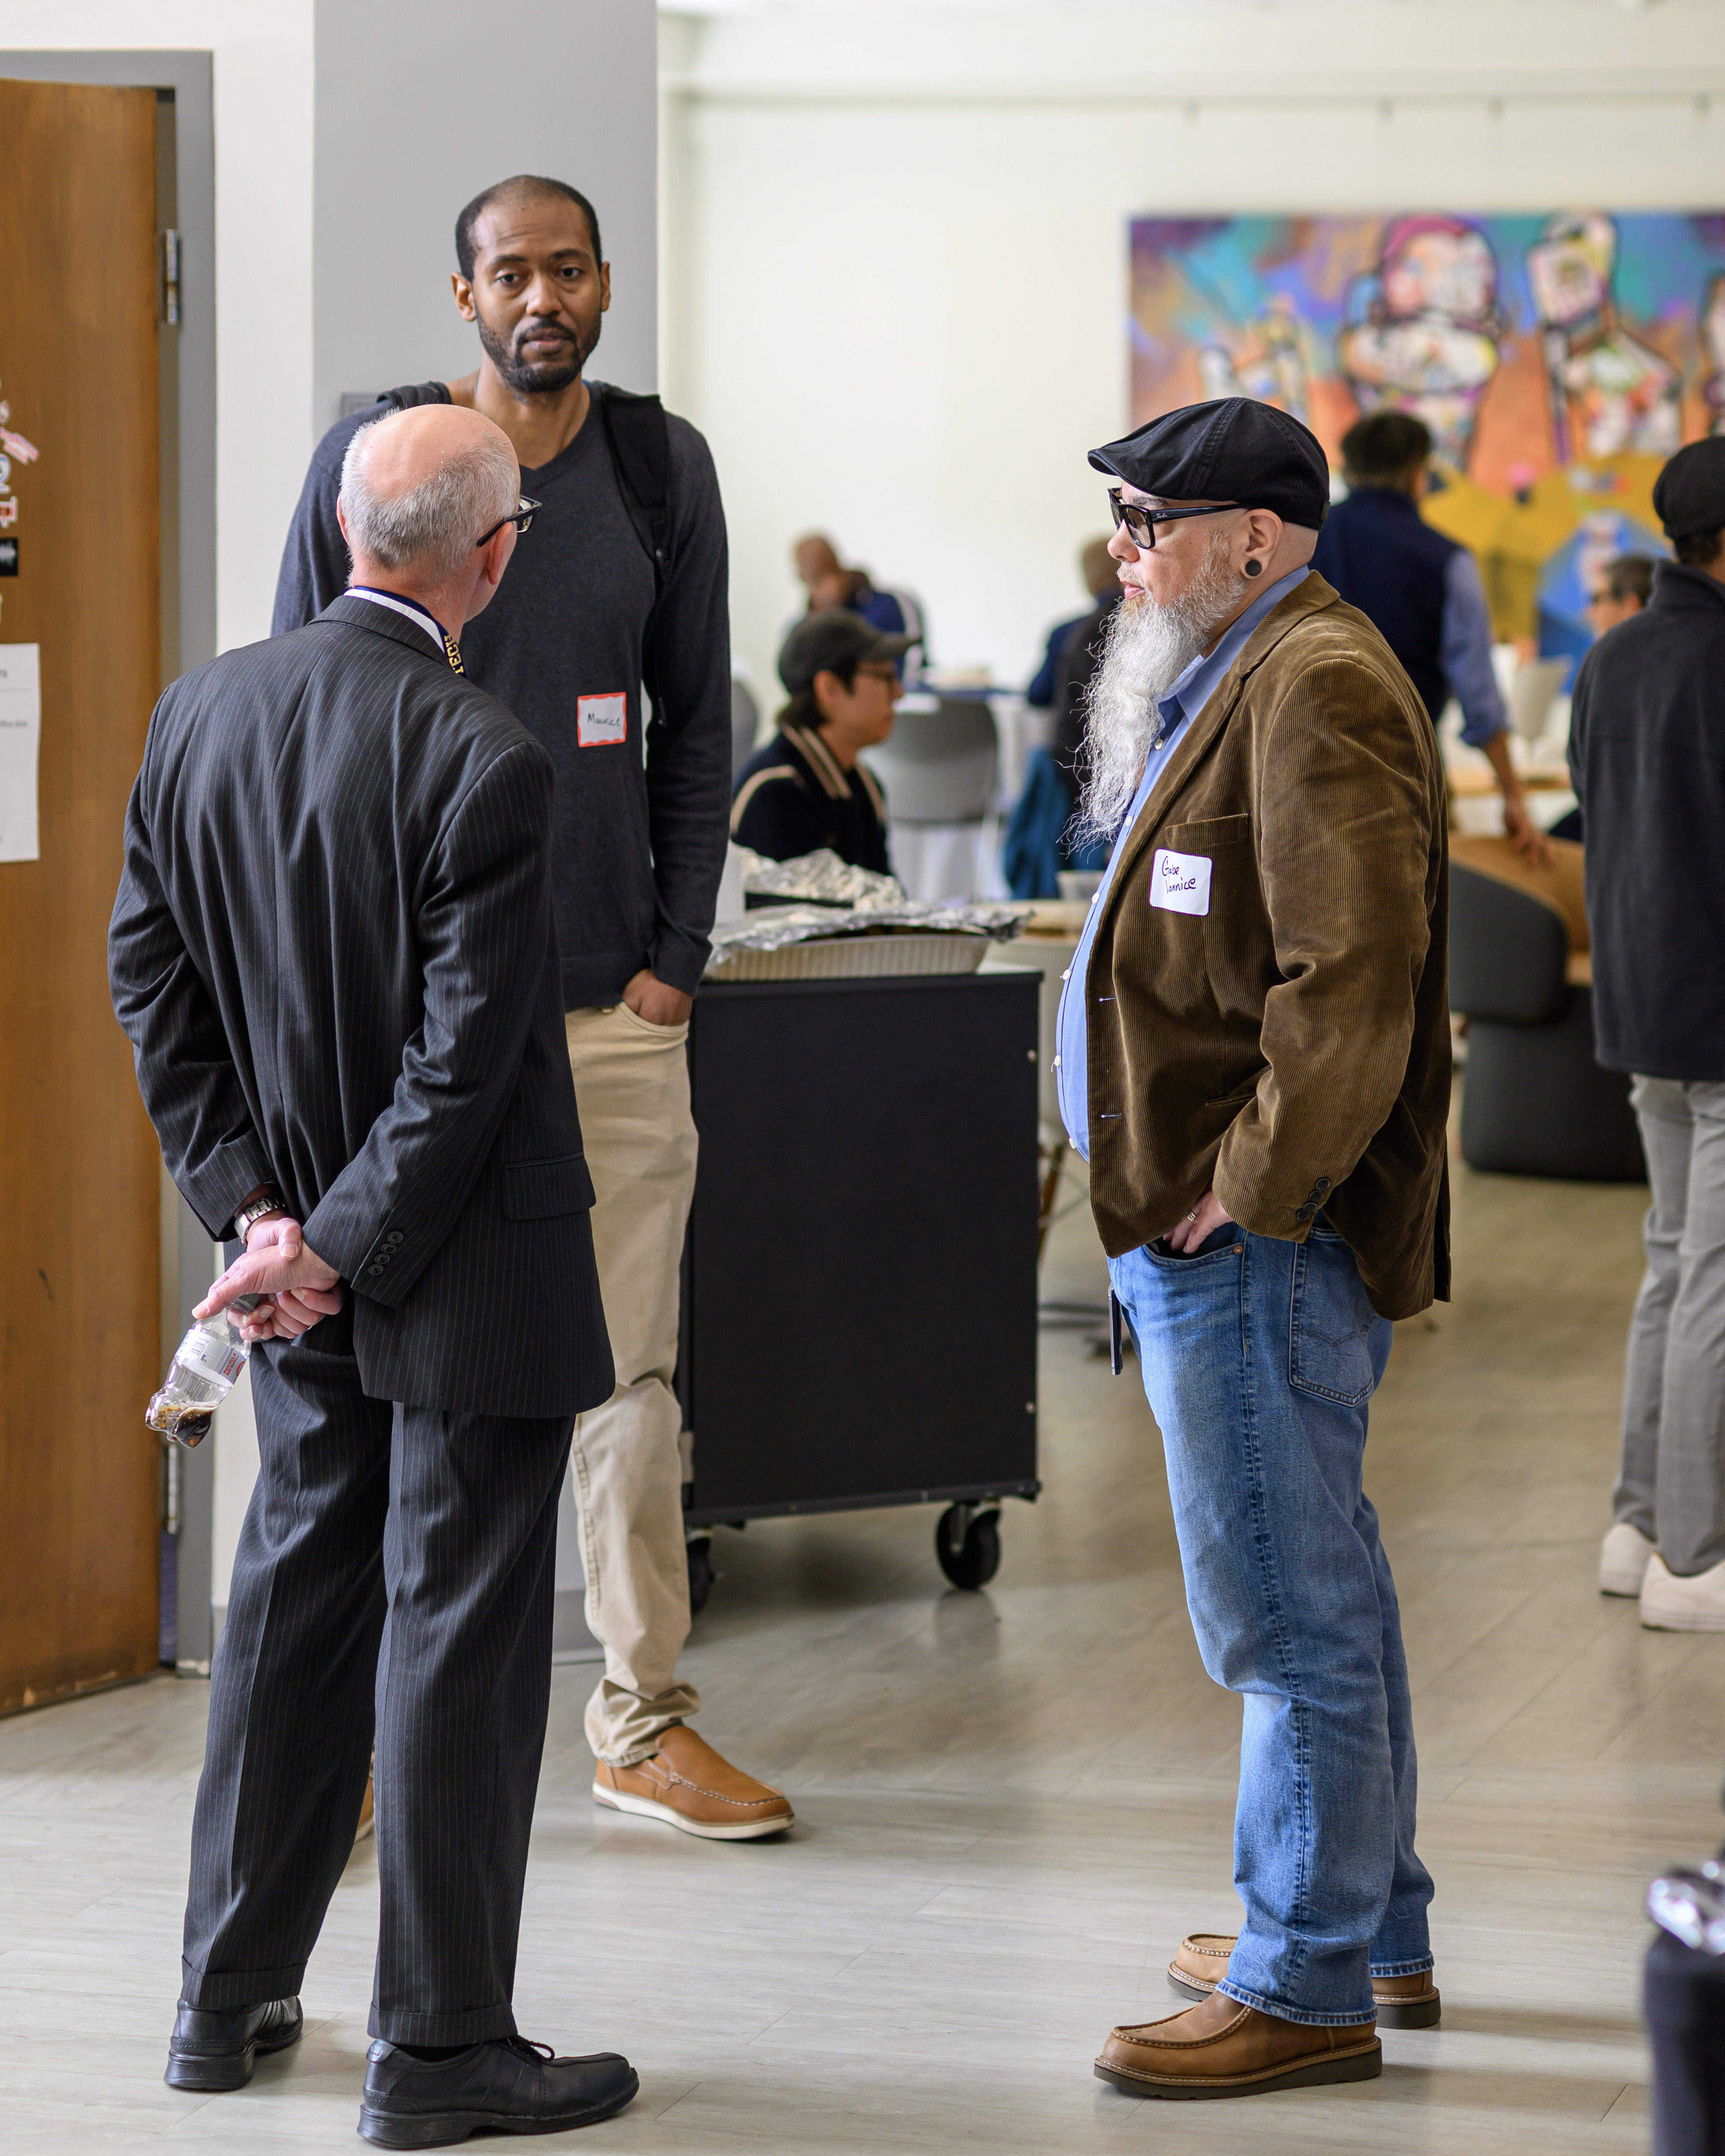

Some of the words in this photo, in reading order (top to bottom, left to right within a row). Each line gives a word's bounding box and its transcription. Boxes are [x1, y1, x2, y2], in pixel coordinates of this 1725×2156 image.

[444, 634, 464, 673] TECH
[1162, 856, 1179, 876] Gabe
[223, 1352, 237, 1374] RECYCLE
